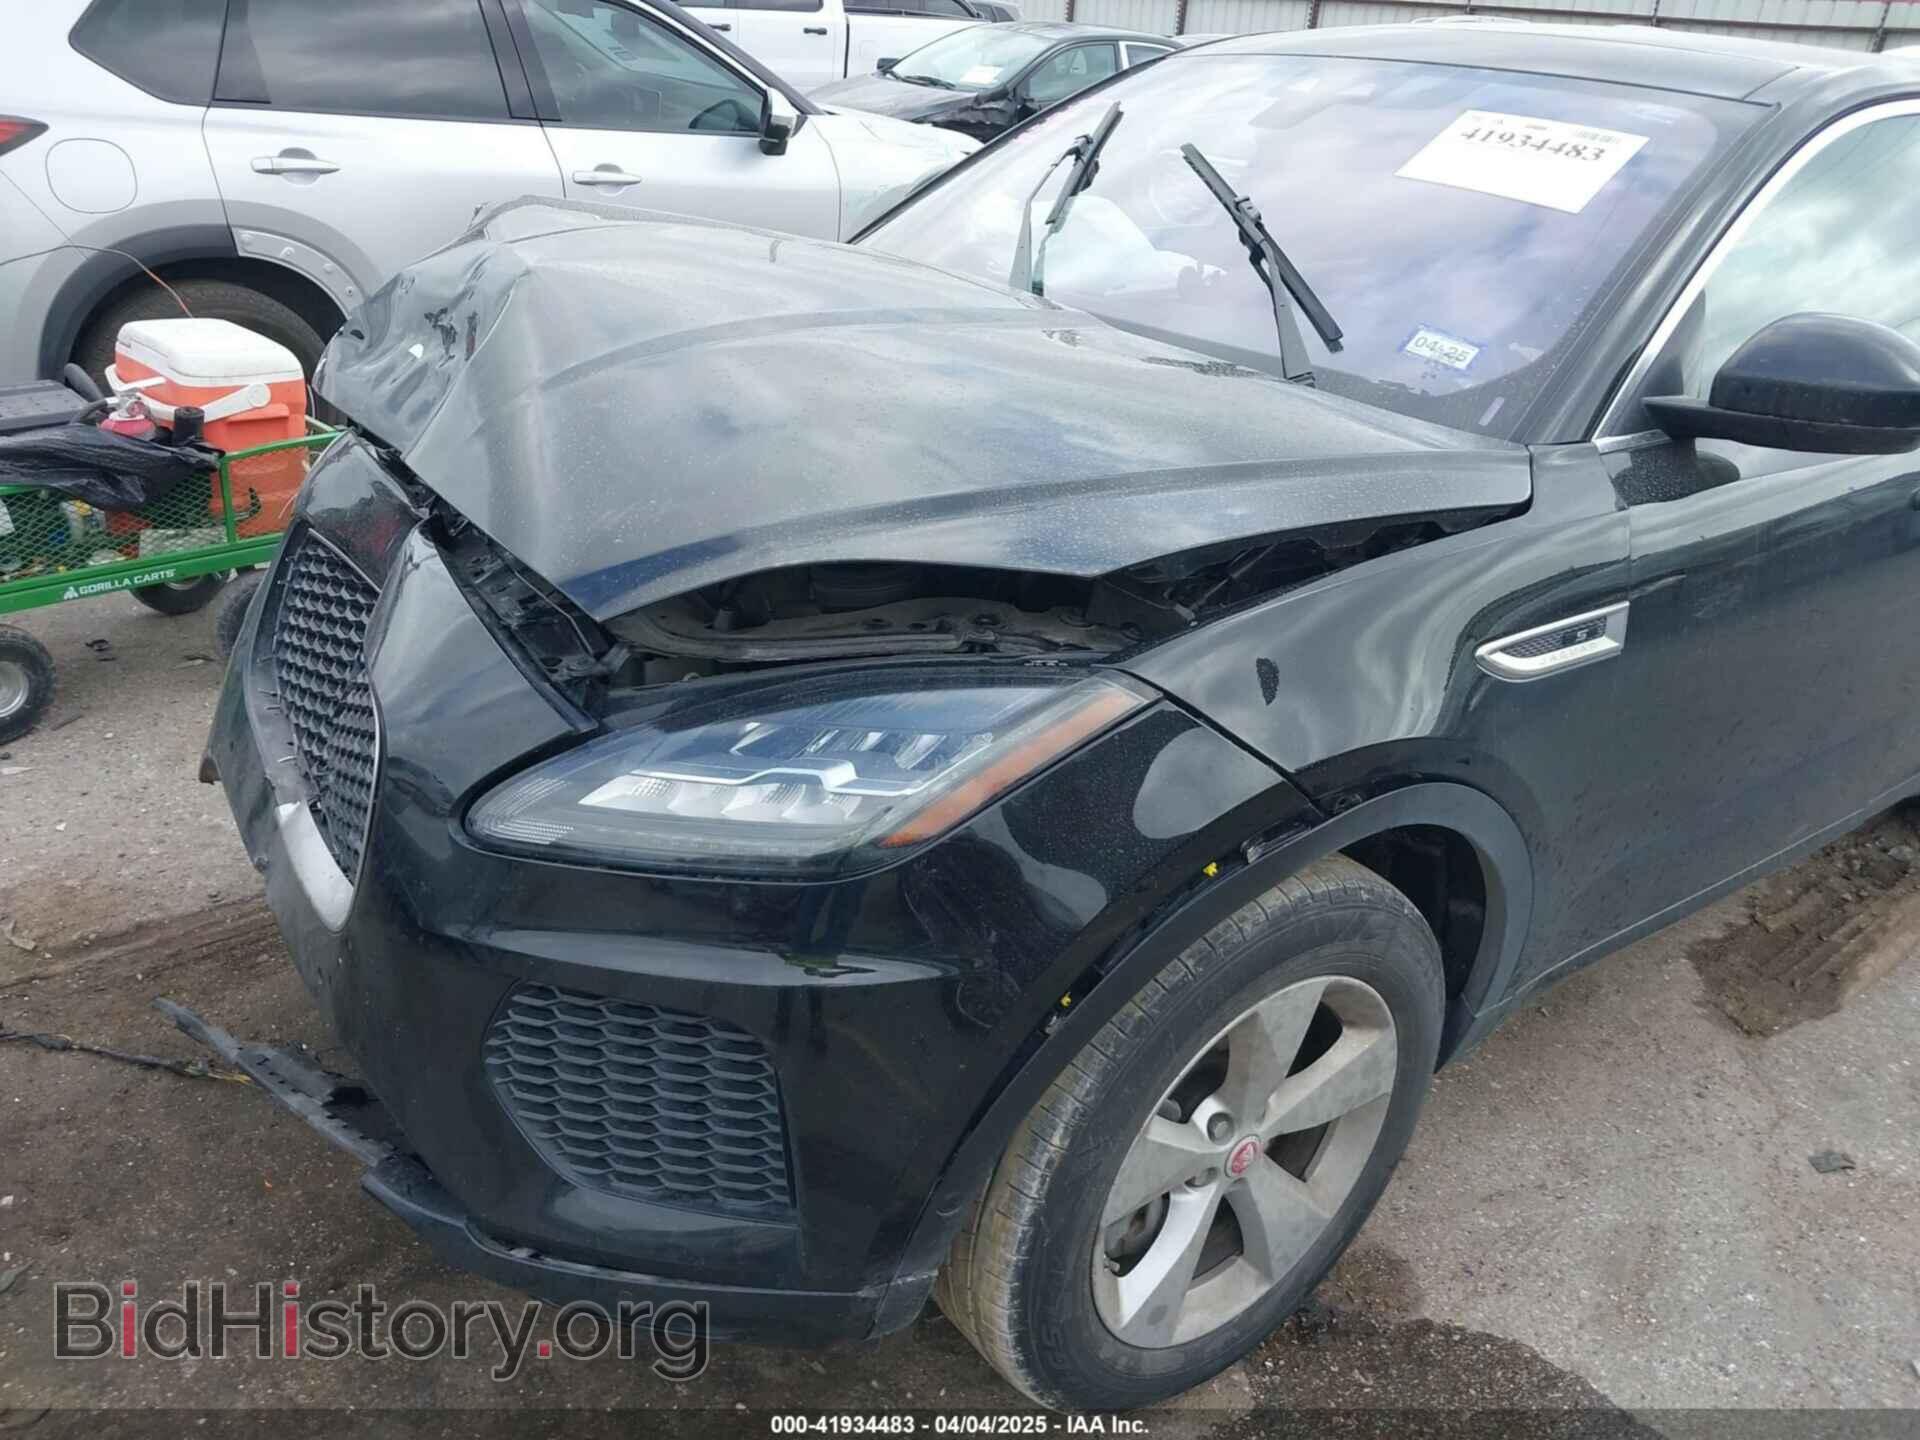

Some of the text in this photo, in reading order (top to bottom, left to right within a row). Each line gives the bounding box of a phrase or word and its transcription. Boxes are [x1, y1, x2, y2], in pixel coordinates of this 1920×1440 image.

[1460, 127, 1606, 161] 41934483
[79, 569, 174, 596] GORILLA CARTS
